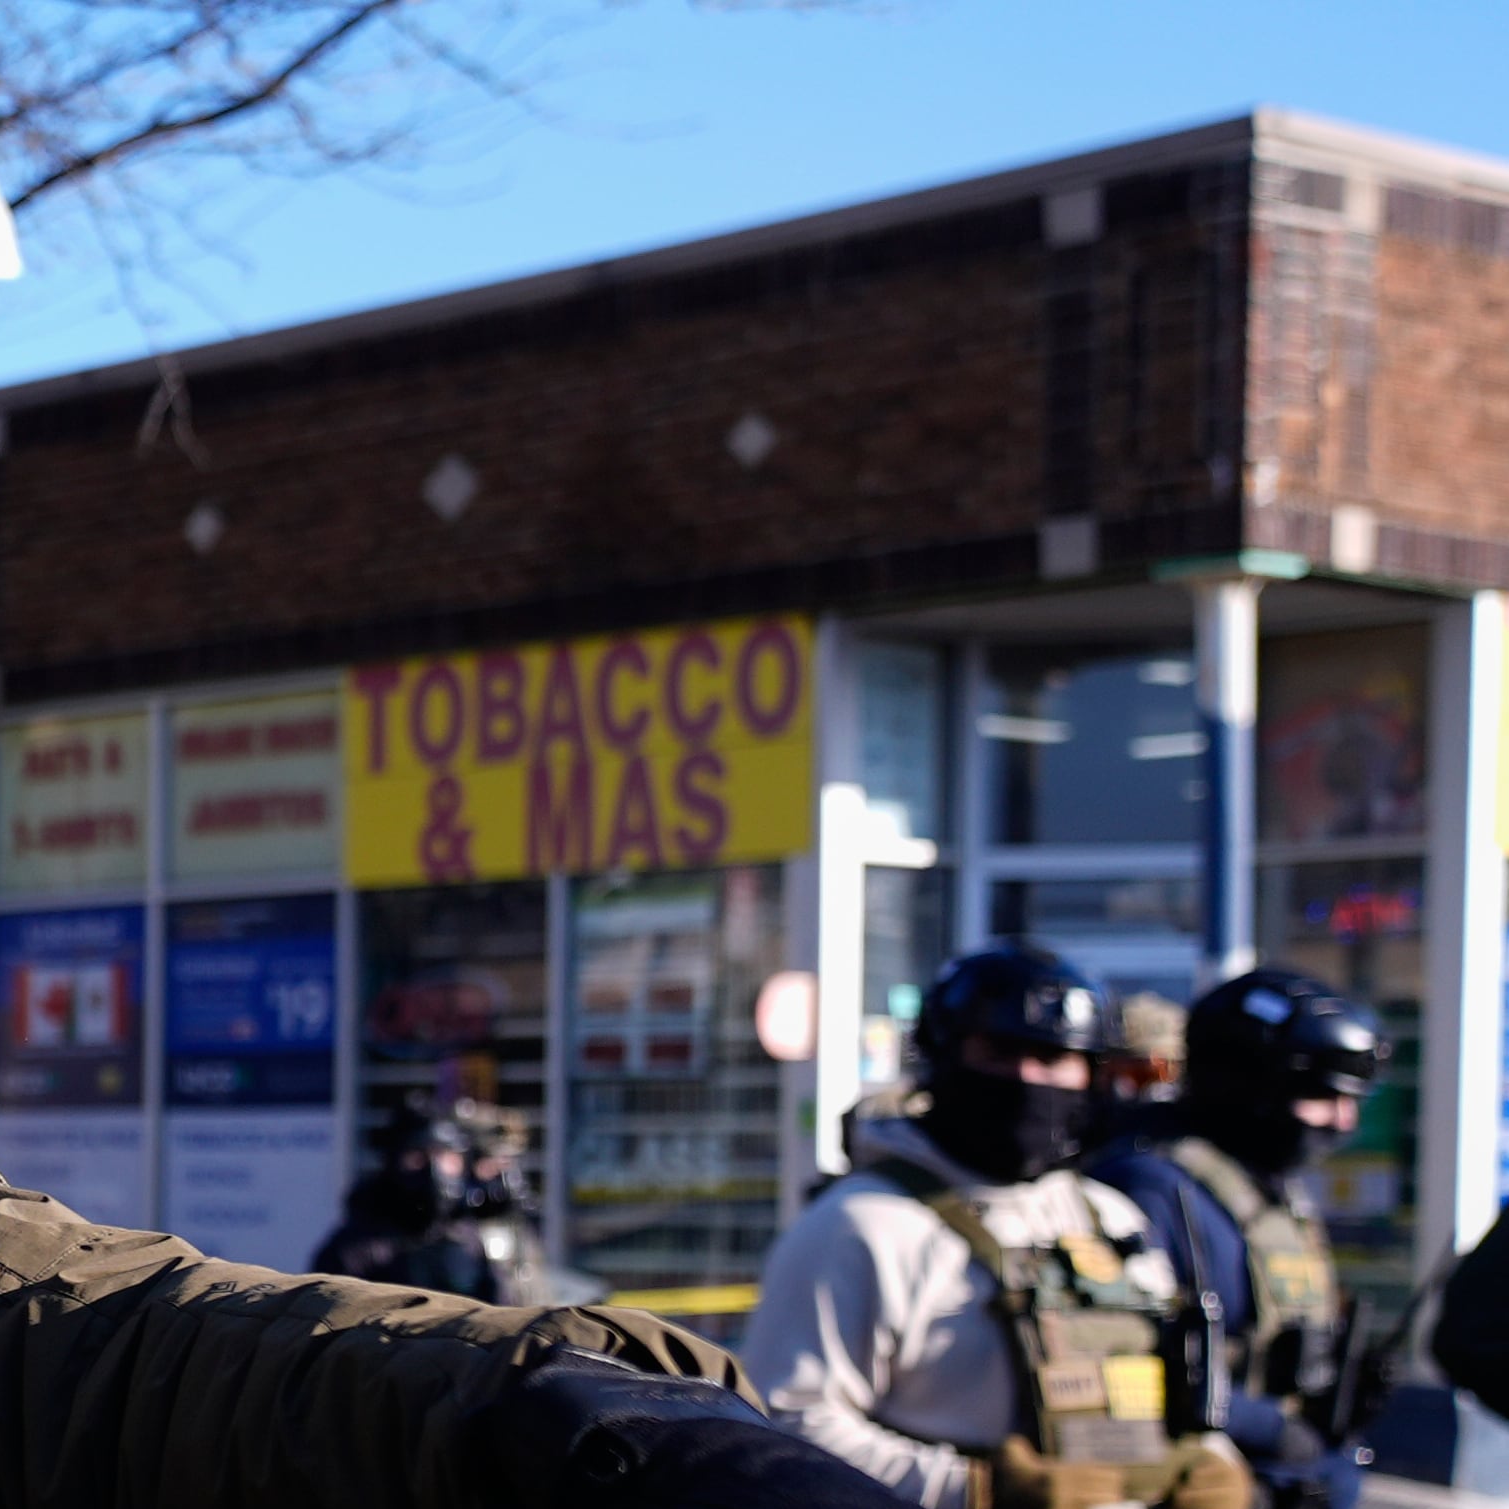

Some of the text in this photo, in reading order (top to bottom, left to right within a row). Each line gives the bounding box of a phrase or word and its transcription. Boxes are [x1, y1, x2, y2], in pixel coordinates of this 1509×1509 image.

[355, 617, 802, 774] TOBACCO
[416, 748, 731, 884] & MAS
